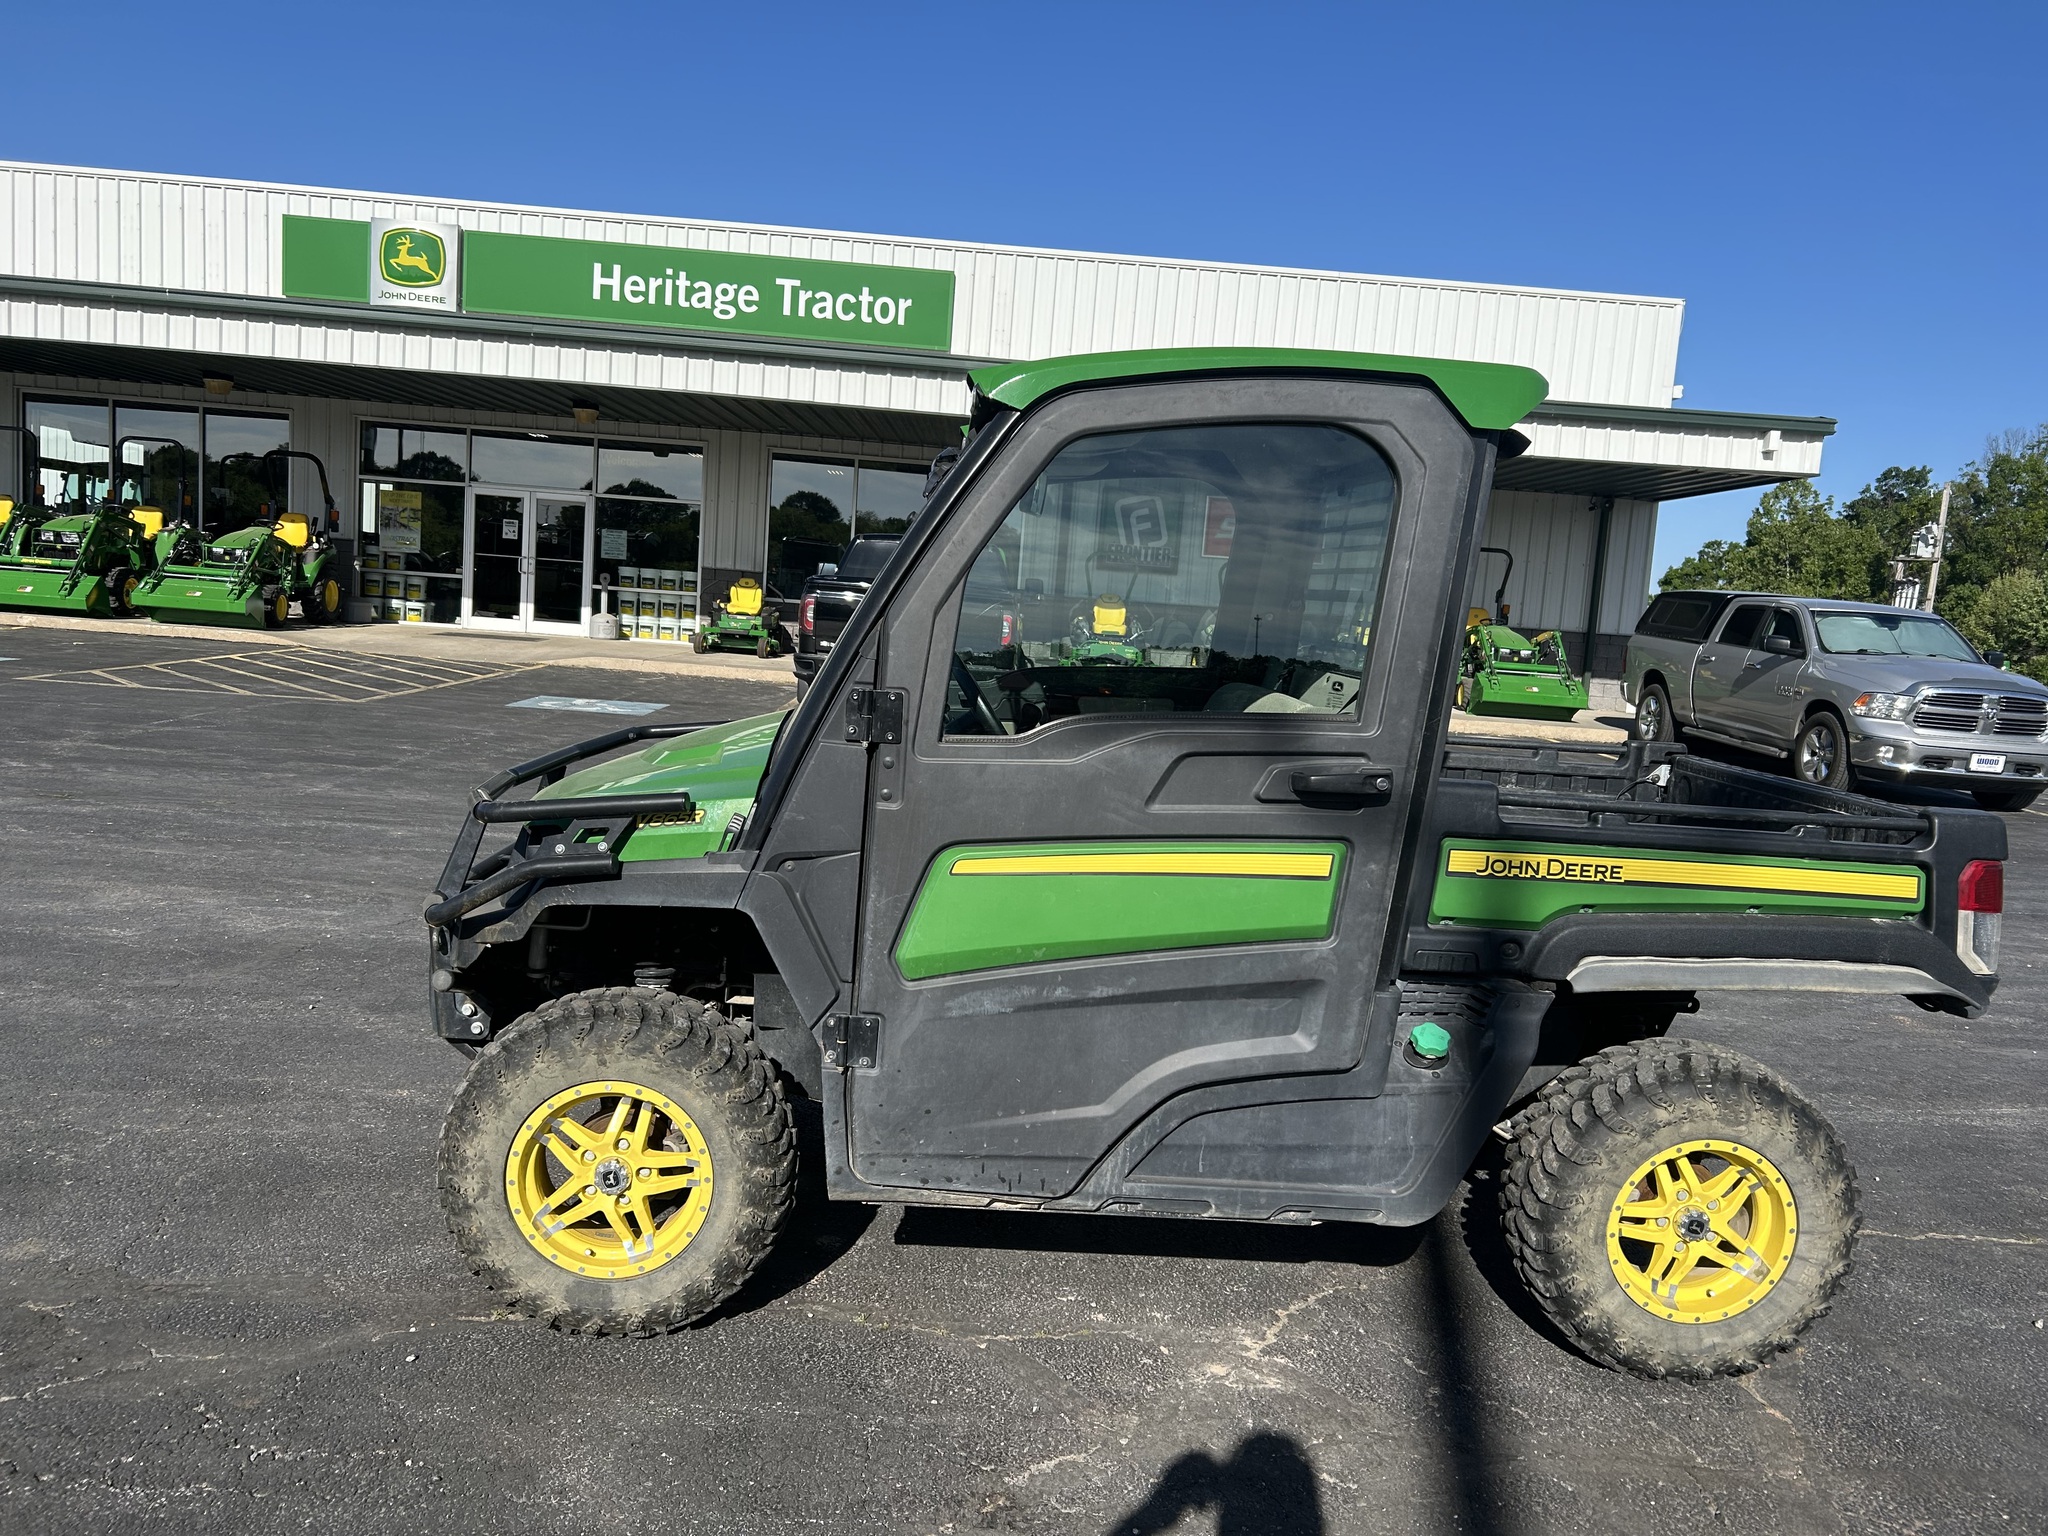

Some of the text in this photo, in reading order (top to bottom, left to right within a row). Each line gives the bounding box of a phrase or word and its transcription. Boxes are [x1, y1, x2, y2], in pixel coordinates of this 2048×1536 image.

[378, 290, 447, 304] JOHN DEERE
[593, 262, 912, 326] Heritage Tractor
[1106, 544, 1172, 565] FRONTIER
[1976, 758, 2000, 766] WOOD
[1476, 855, 1624, 881] JOHN DEERE
